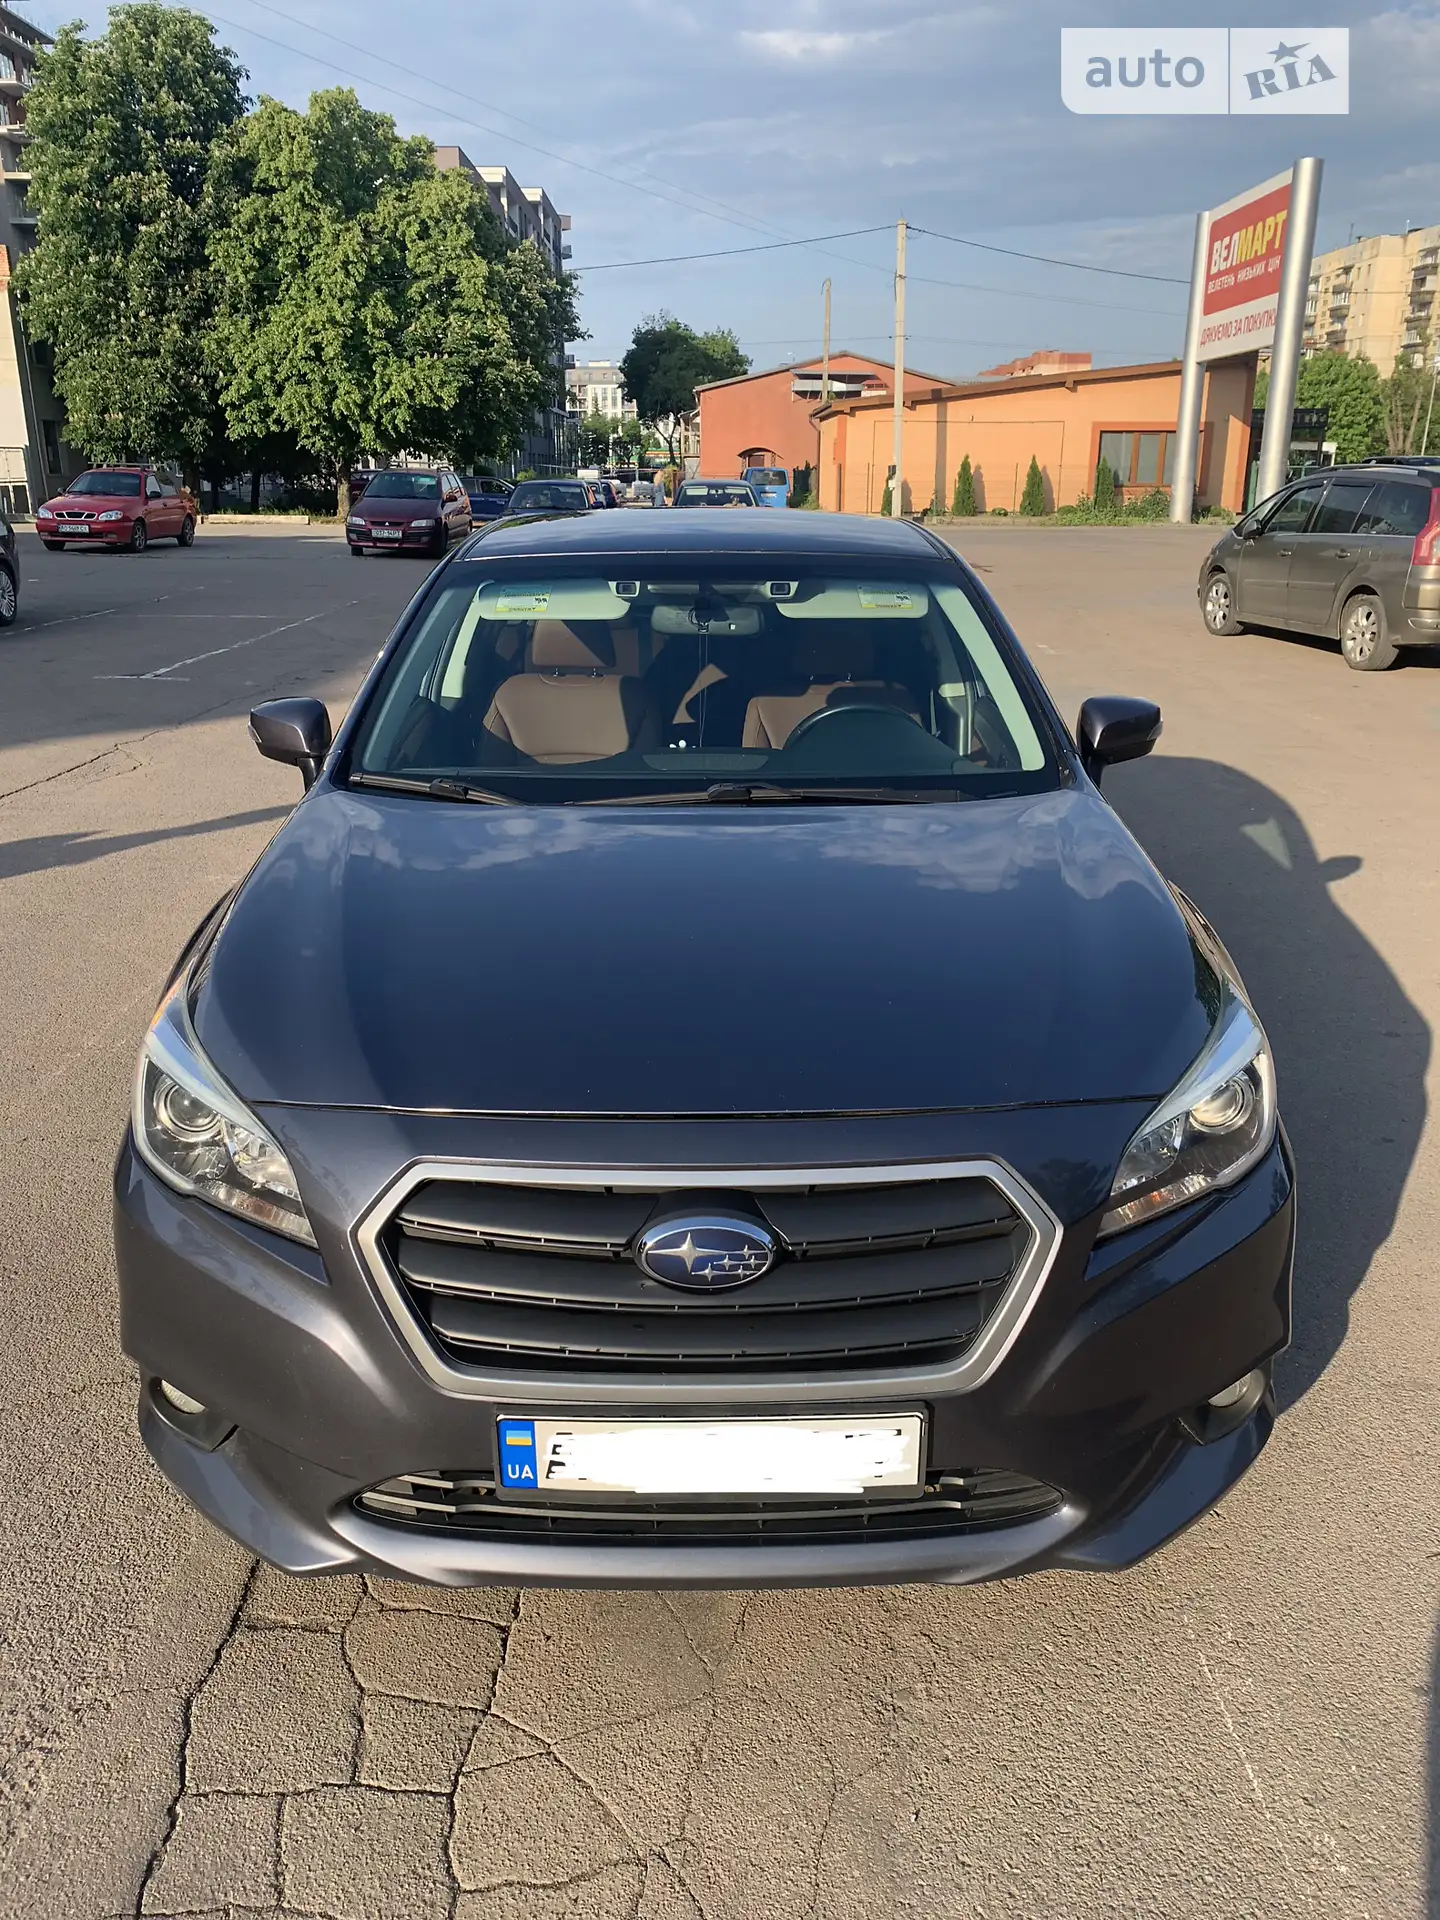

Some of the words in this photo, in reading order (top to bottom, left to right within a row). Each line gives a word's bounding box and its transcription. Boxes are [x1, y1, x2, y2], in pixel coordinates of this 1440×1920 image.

[1210, 209, 1287, 275] ВЕЛМАРТ
[1233, 318, 1242, 337] ЗА
[507, 1464, 534, 1480] UA
